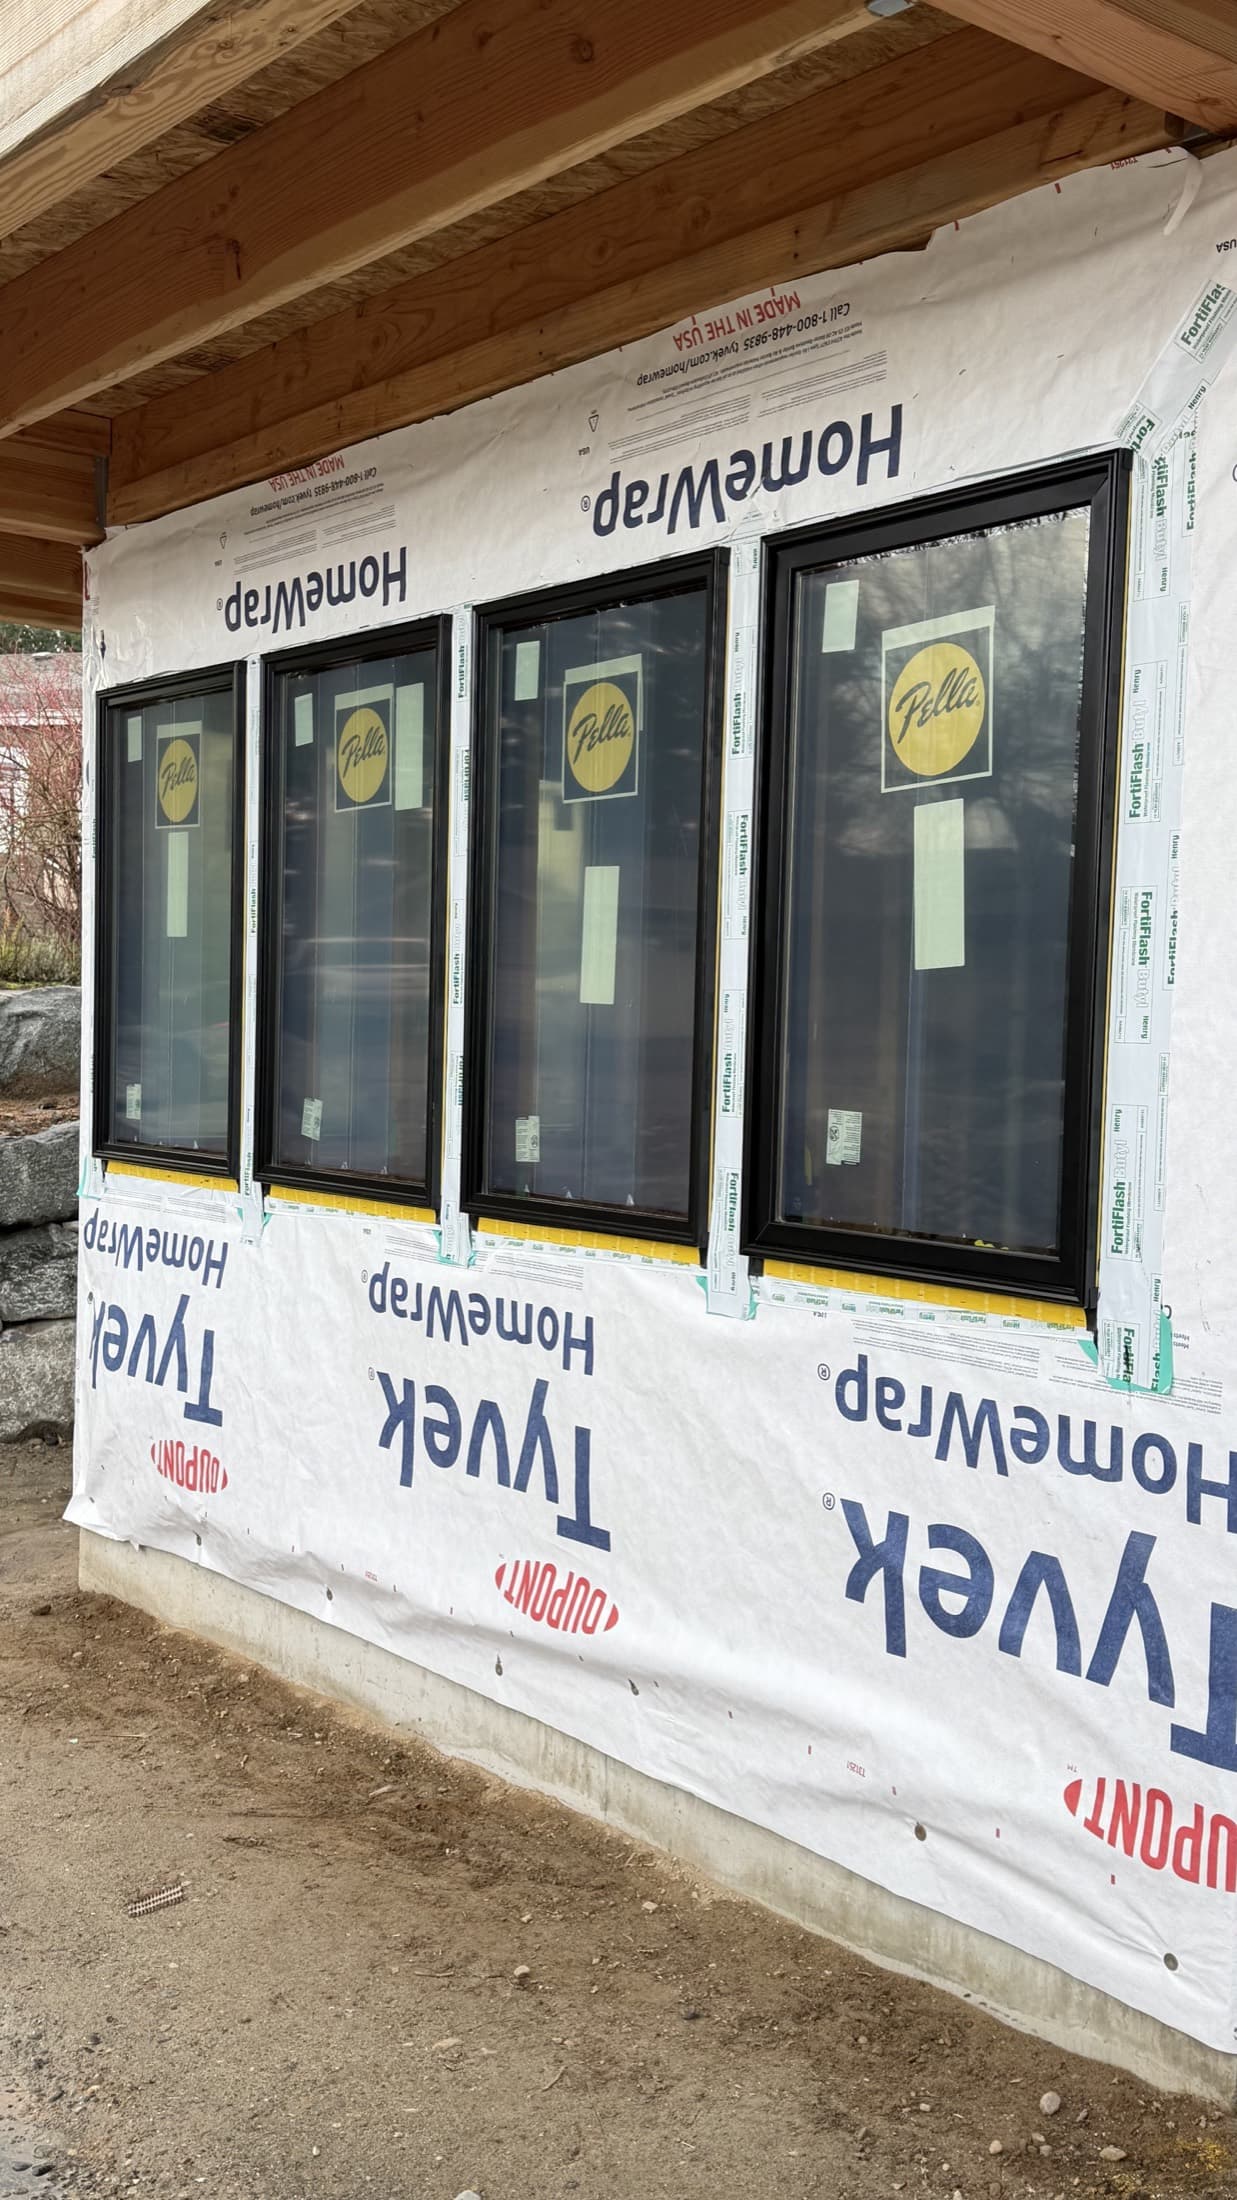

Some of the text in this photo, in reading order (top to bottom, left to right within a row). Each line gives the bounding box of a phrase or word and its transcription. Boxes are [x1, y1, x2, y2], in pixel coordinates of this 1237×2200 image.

[1216, 238, 1237, 254] USA
[636, 302, 850, 387] Call 1-800-448-9835 tyvek.com/homewrap
[672, 291, 801, 352] MADE IN THE USA
[268, 455, 345, 493] MADE IN THE USA
[1160, 567, 1169, 592] Henry
[457, 645, 465, 699] FortiFlash
[1132, 669, 1141, 694] Henry
[572, 703, 630, 765] Pella
[732, 693, 742, 755] FortiFlash
[895, 666, 979, 744] Pella
[161, 756, 196, 800] Pella
[341, 726, 385, 779] Pella
[1129, 743, 1144, 818] FortiFlash
[738, 814, 749, 876] FortiFlash
[1136, 891, 1153, 1040] FortiFlash Butyl Henry
[722, 1052, 732, 1113] FortiFlash
[728, 1172, 739, 1232] FortiFlash
[1110, 1108, 1129, 1255] FortiFlash Butyl Henry
[83, 1207, 229, 1289] HomeWrap
[1153, 1278, 1161, 1303] Henry
[157, 1439, 221, 1494] DUPONT
[503, 1559, 607, 1635] DUPONT
[1083, 1777, 1237, 1893] UPONT
